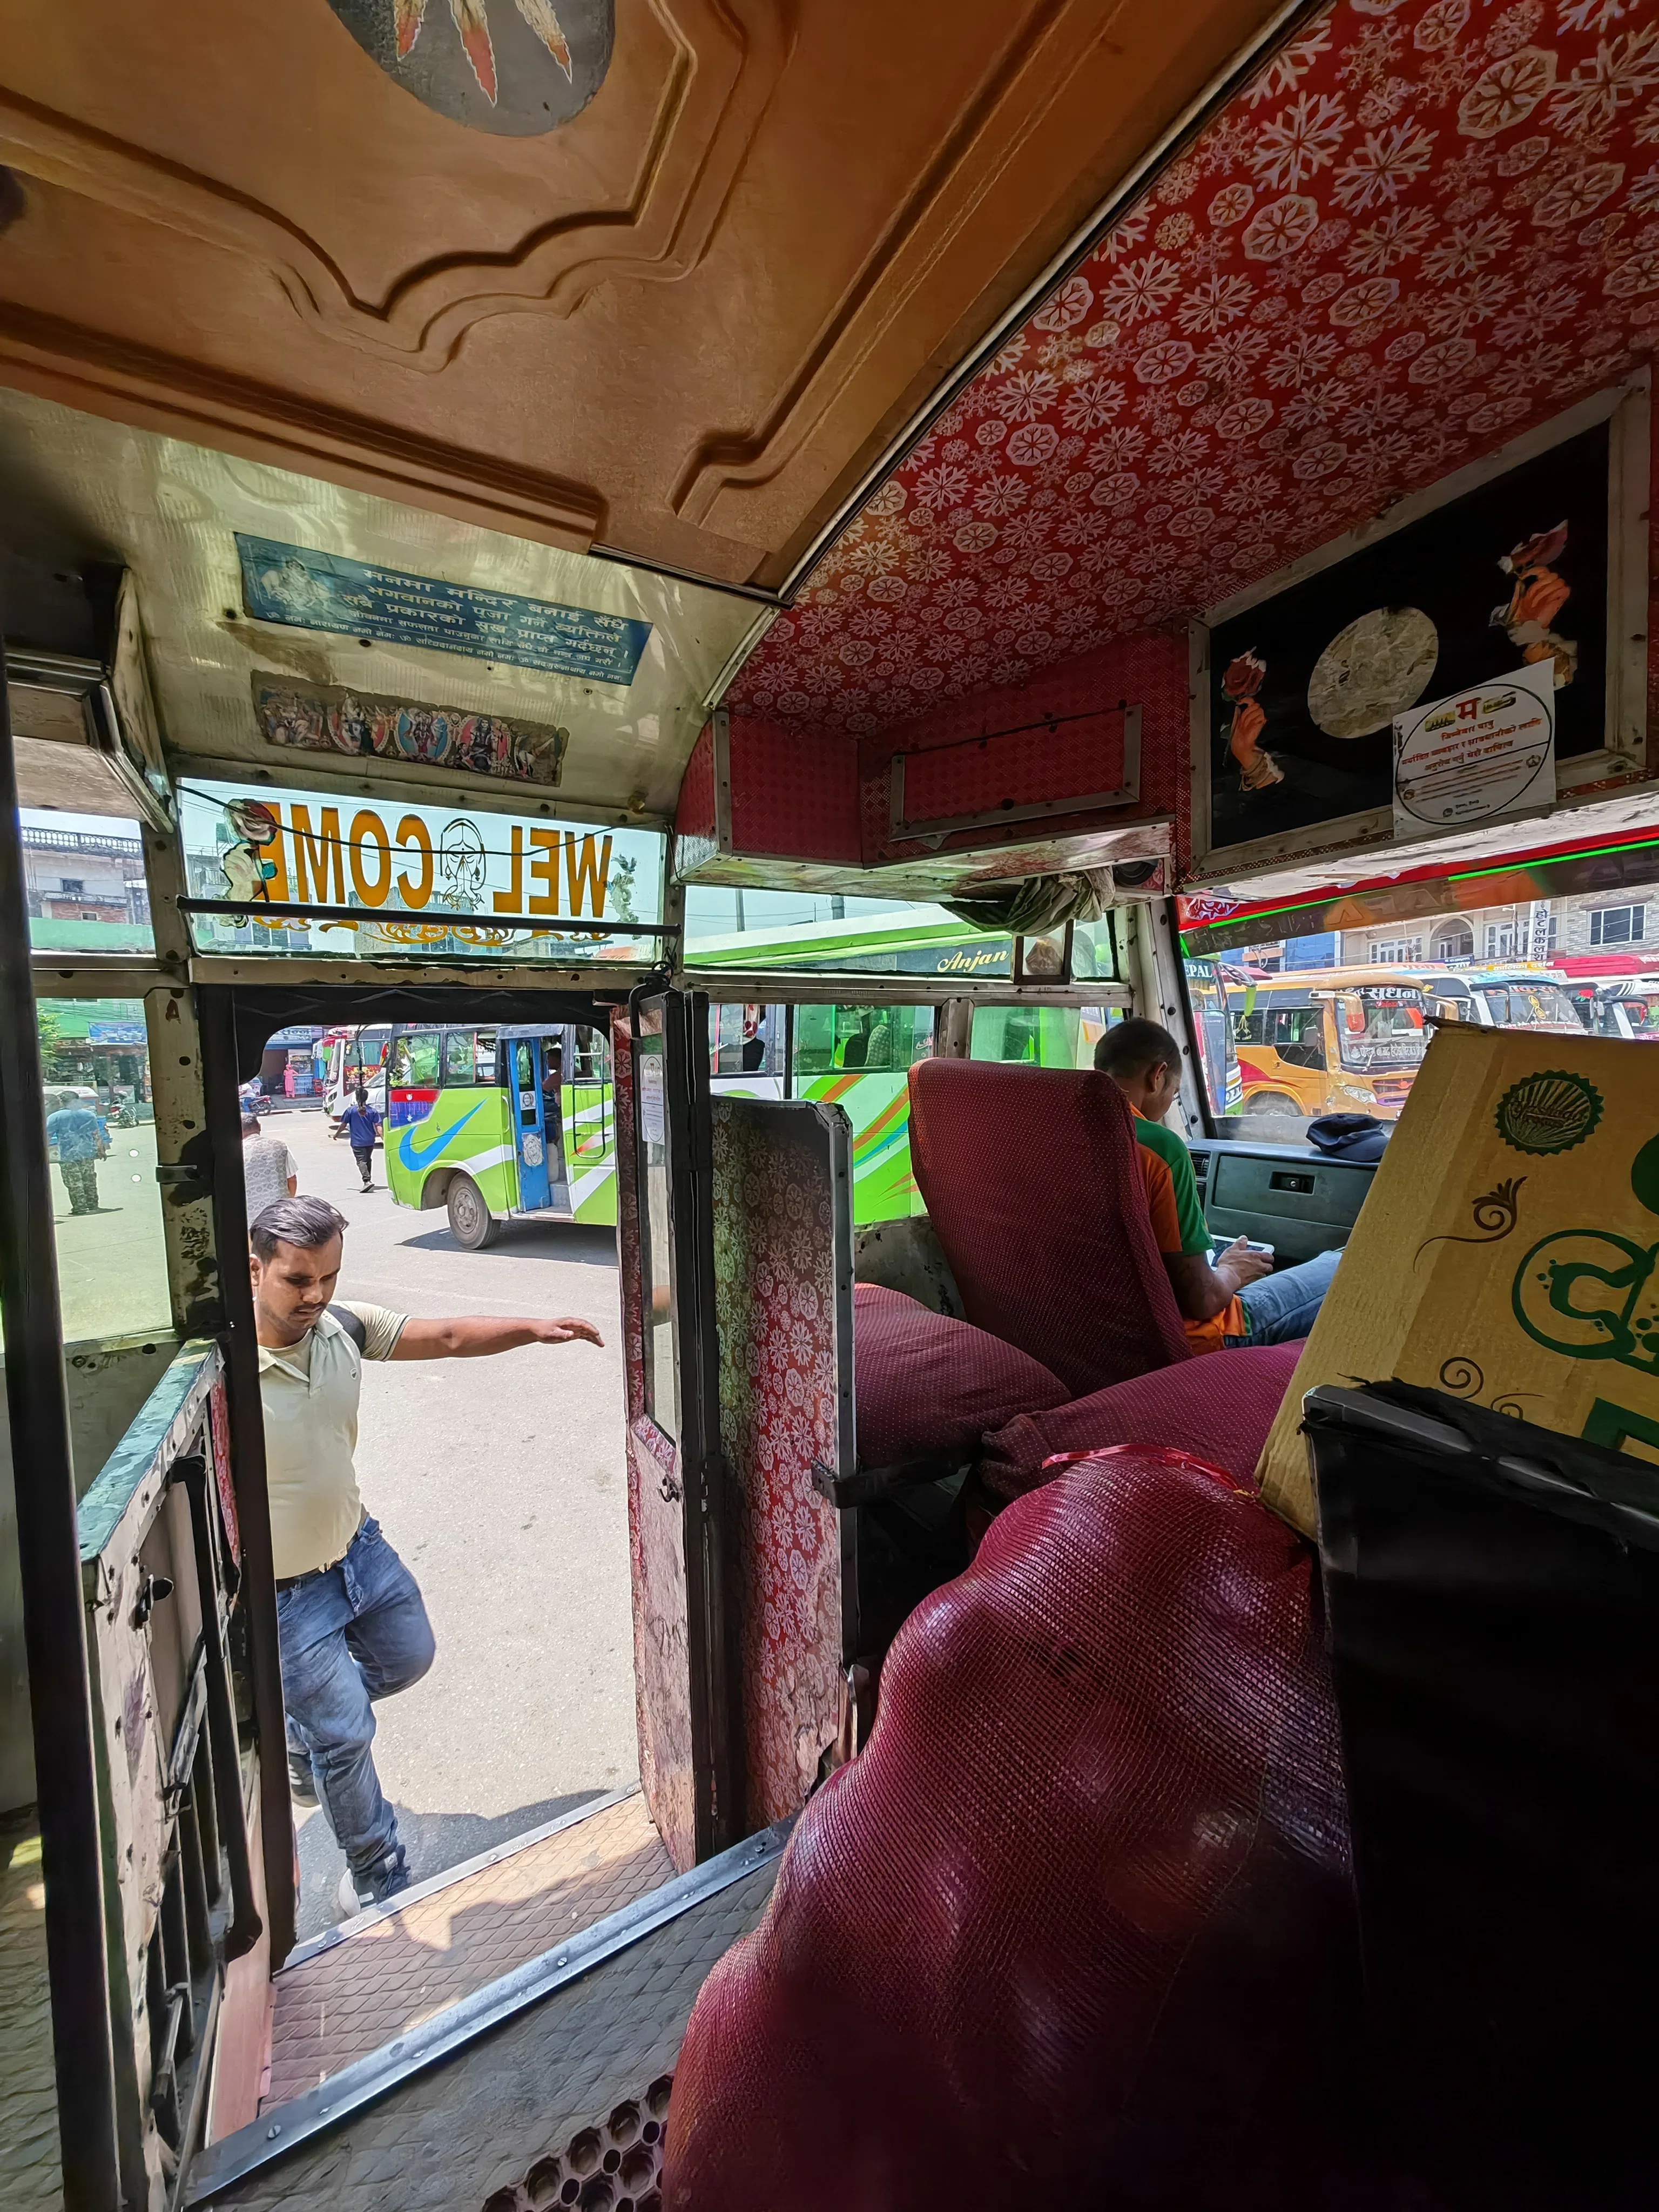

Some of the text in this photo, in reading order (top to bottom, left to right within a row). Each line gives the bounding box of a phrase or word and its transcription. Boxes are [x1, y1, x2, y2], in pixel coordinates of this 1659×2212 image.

[363, 569, 435, 592] मनमा
[446, 587, 518, 610] मन्दिर
[527, 603, 584, 622] बनाई
[366, 585, 463, 611] भगवानको
[471, 606, 511, 621] पूजा
[384, 602, 466, 625] प्रकारको
[474, 619, 508, 634] सुख
[516, 628, 556, 644] प्राप्त
[1455, 697, 1482, 720] म
[937, 949, 1009, 973] Anjan
